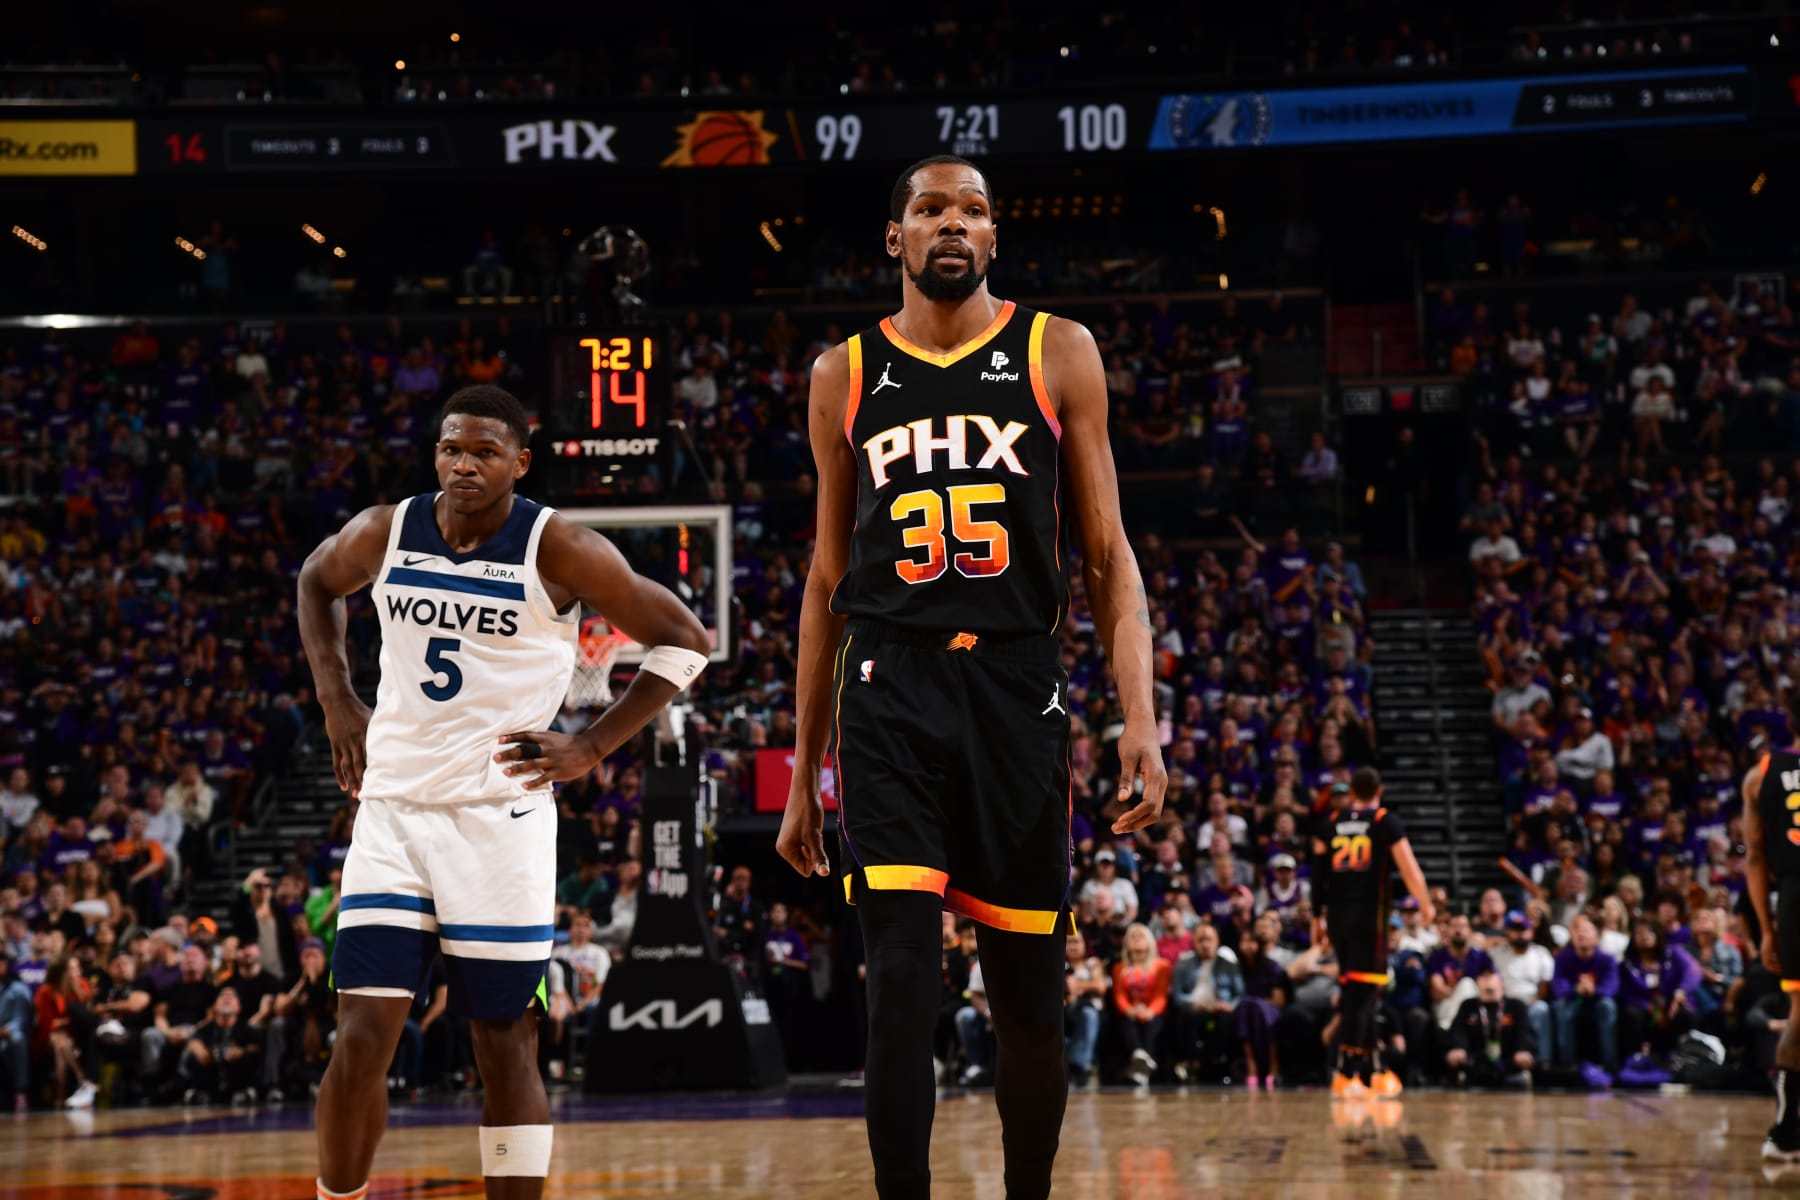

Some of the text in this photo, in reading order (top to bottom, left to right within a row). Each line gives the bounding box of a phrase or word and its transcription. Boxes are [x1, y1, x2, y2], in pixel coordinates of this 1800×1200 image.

[935, 104, 999, 142] 7:21
[1057, 103, 1128, 152] 100
[1298, 98, 1476, 124] TIMBERWOLVES
[165, 132, 208, 165] 14
[501, 119, 620, 165] PHX
[815, 113, 863, 163] 99
[579, 337, 652, 371] 7:21
[980, 371, 1020, 382] PayPal
[591, 370, 646, 429] 14
[580, 438, 660, 456] TISSOT
[862, 415, 1031, 490] PHX
[890, 483, 1010, 584] 35
[386, 595, 519, 637] WOLVES
[420, 636, 463, 702] 5
[684, 664, 696, 677] 5
[652, 820, 682, 844] GET
[654, 844, 682, 869] THE
[1331, 834, 1372, 871] 20
[631, 944, 674, 962] Google
[609, 999, 723, 1031] KIA
[496, 1143, 507, 1156] 5
